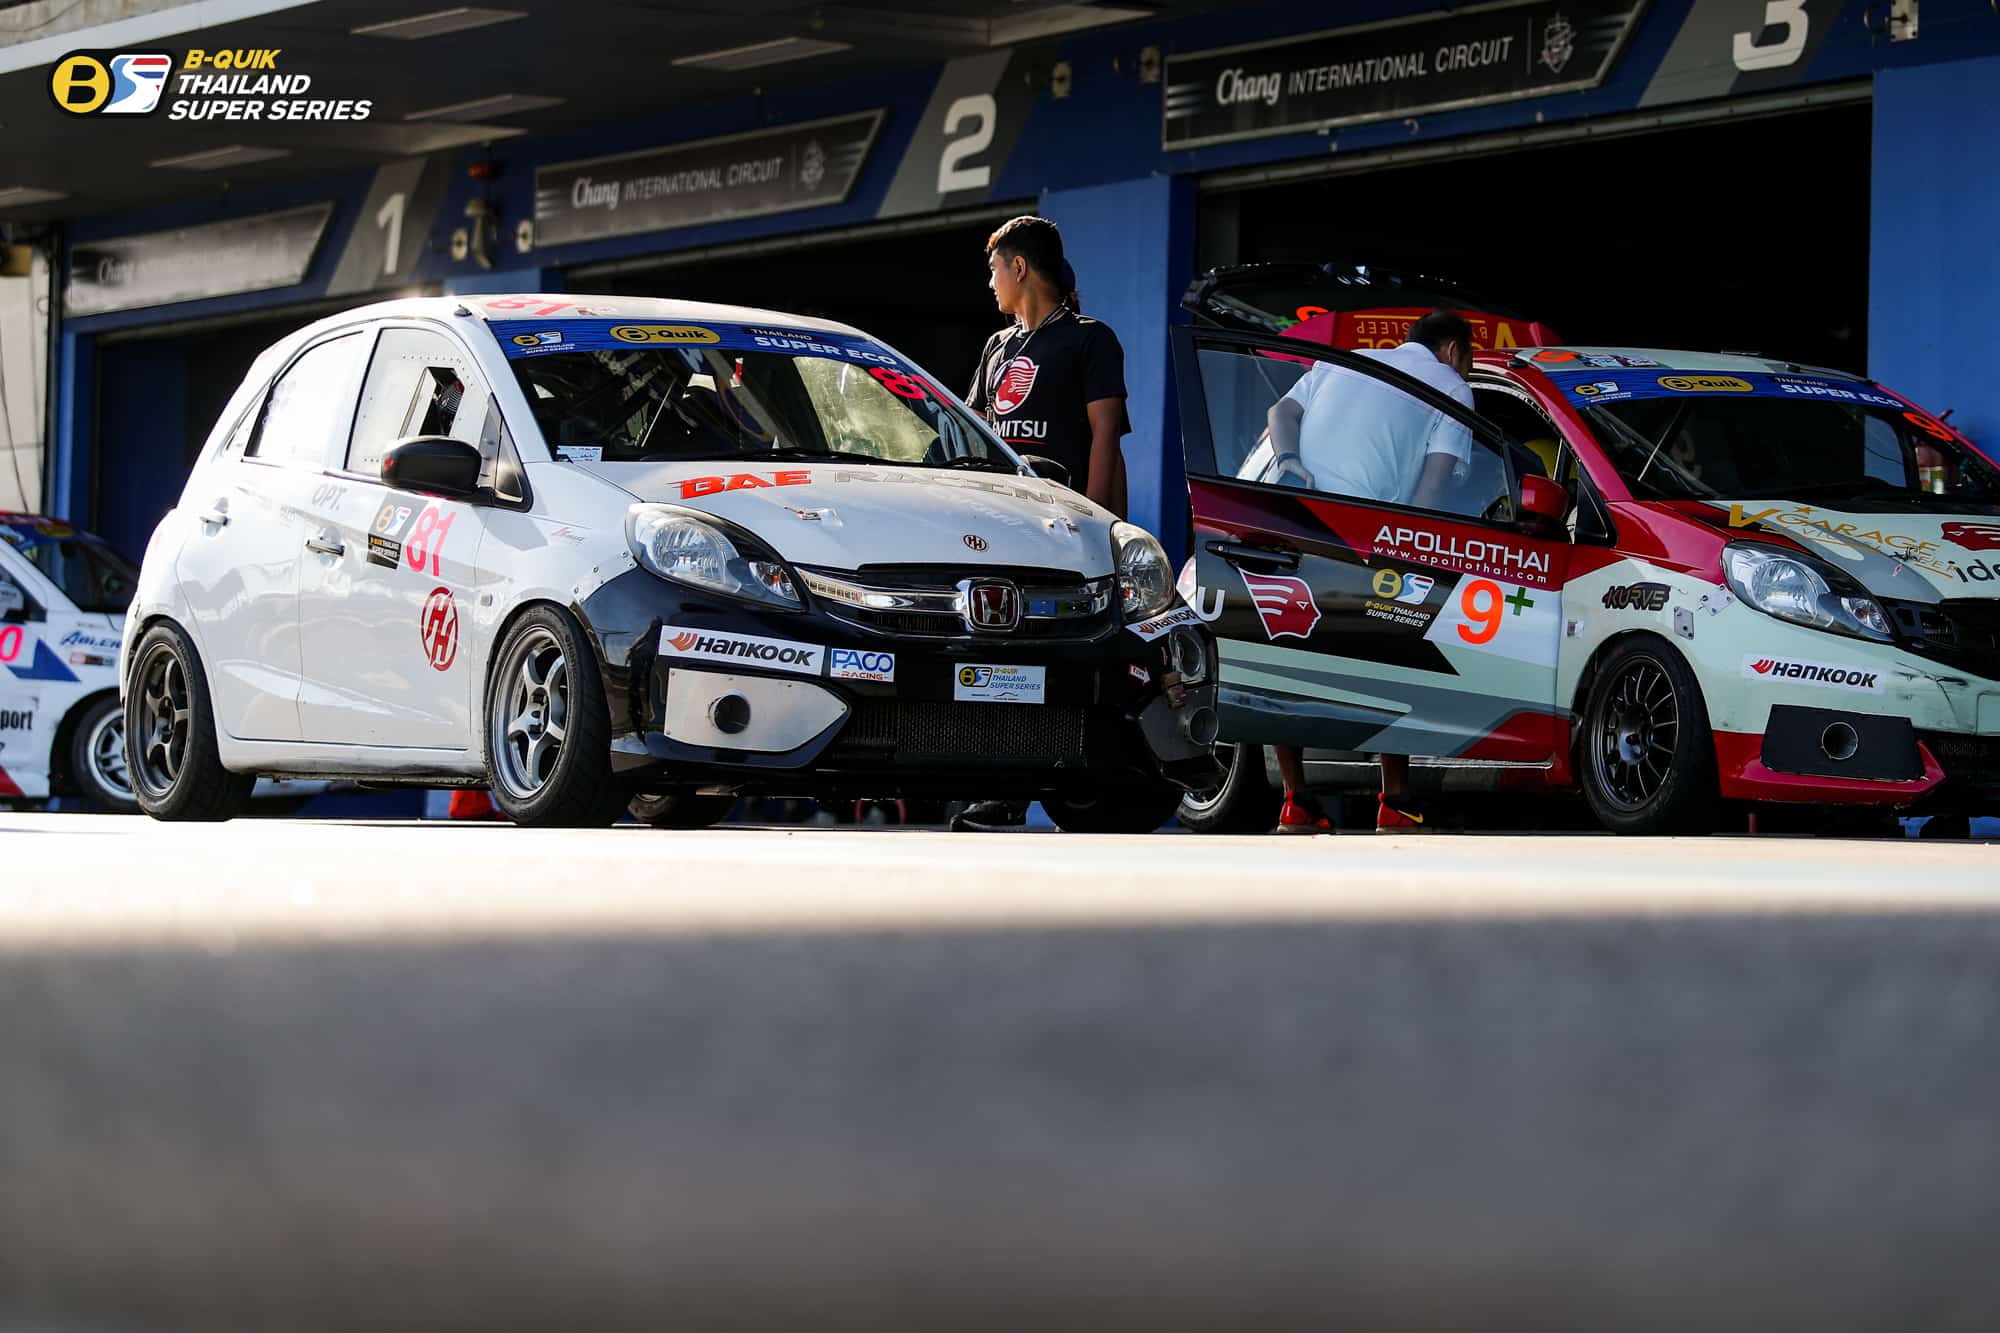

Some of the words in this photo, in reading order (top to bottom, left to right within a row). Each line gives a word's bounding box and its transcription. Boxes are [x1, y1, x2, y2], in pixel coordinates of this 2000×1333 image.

[1216, 69, 1281, 105] Chang
[1288, 56, 1427, 95] INTERNATIONAL
[1435, 37, 1513, 72] CIRCUIT
[937, 94, 997, 193] 2
[571, 178, 620, 210] Chang
[625, 168, 722, 199] INTERNATIONAL
[727, 157, 783, 187] CIRCUIT
[376, 193, 405, 276] 1
[751, 328, 813, 341] THAILAND
[754, 336, 842, 356] SUPER
[847, 349, 897, 365] ECO
[868, 366, 955, 407] 81
[1780, 384, 1857, 400] SUPER
[1859, 393, 1904, 408] ECO
[680, 469, 812, 499] BAE
[406, 505, 456, 577] 81
[1374, 525, 1549, 574] APOLLOTHAI
[1776, 512, 1941, 558] GARAGE
[1373, 546, 1547, 583] www.apollothai.com
[1366, 609, 1394, 621] SUPER
[1393, 615, 1425, 628] SERIES
[1392, 606, 1431, 621] THAILAND
[831, 650, 893, 673] PACO
[841, 671, 884, 681] RACING
[1015, 682, 1040, 690] SERIES
